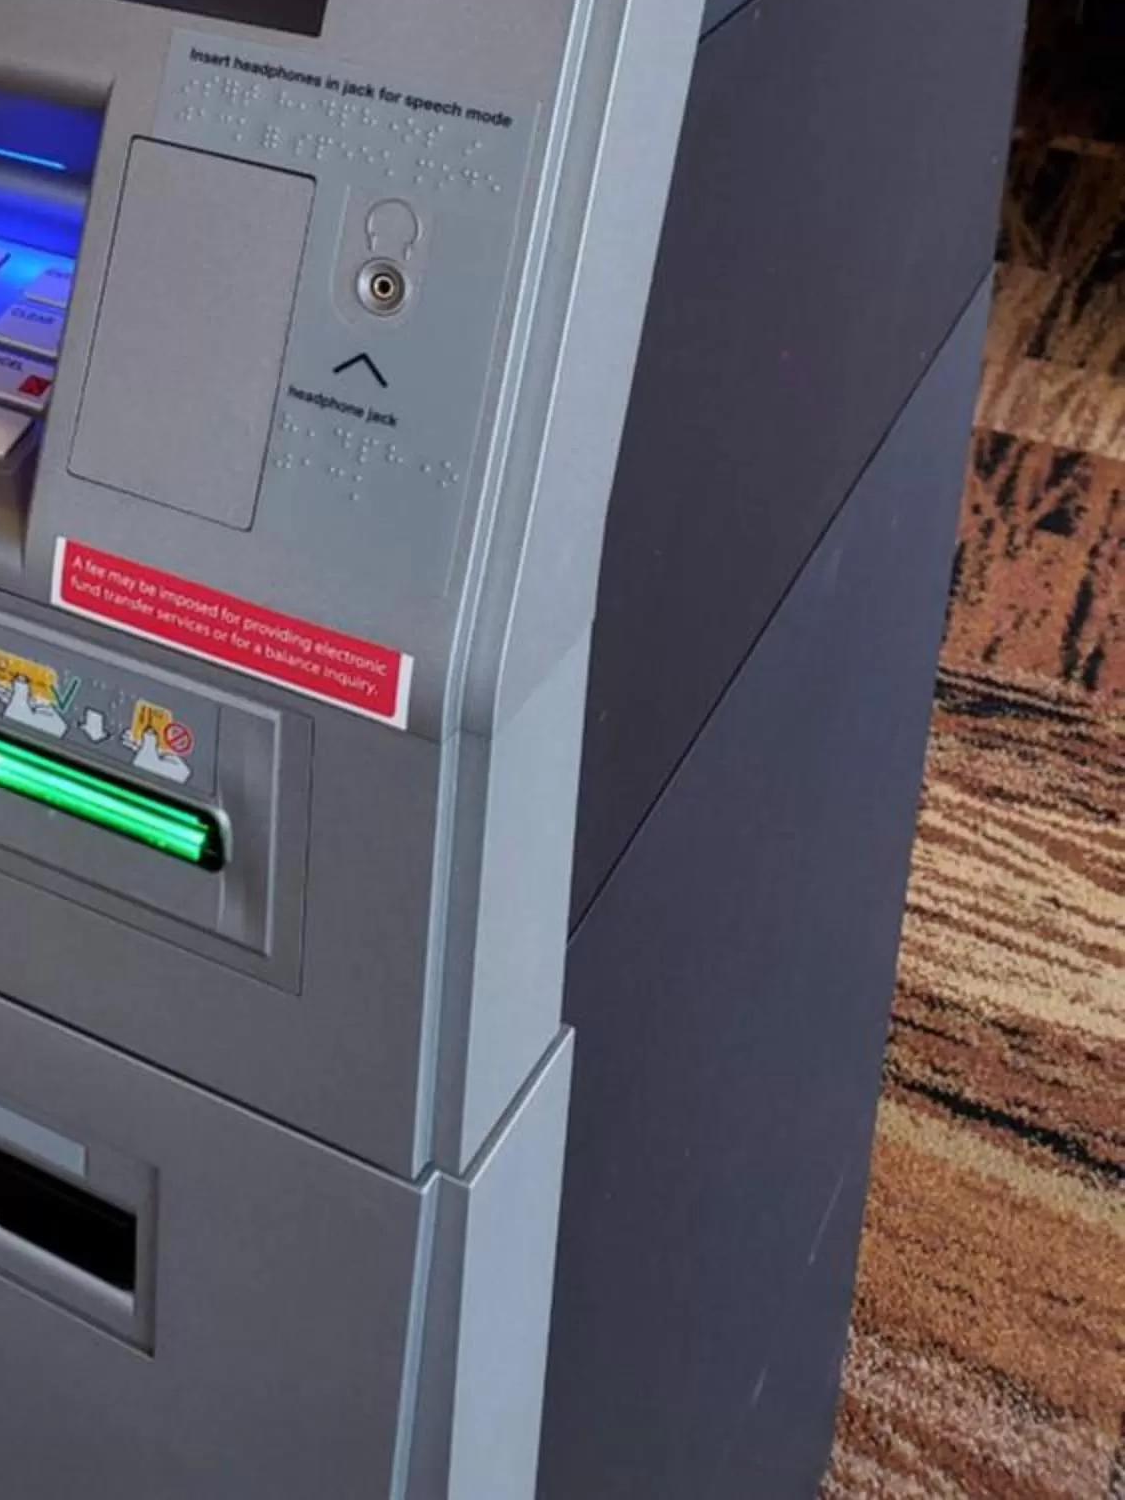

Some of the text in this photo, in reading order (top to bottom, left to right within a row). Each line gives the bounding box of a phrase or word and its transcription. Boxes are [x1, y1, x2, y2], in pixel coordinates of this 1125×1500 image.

[189, 46, 514, 129] Insert headphones in jack for speech mode
[287, 384, 399, 428] headphone jack
[69, 574, 379, 697] fund transfer services or for a balance inquiry.
[71, 555, 388, 677] A fee may be imposed for providing electronic
